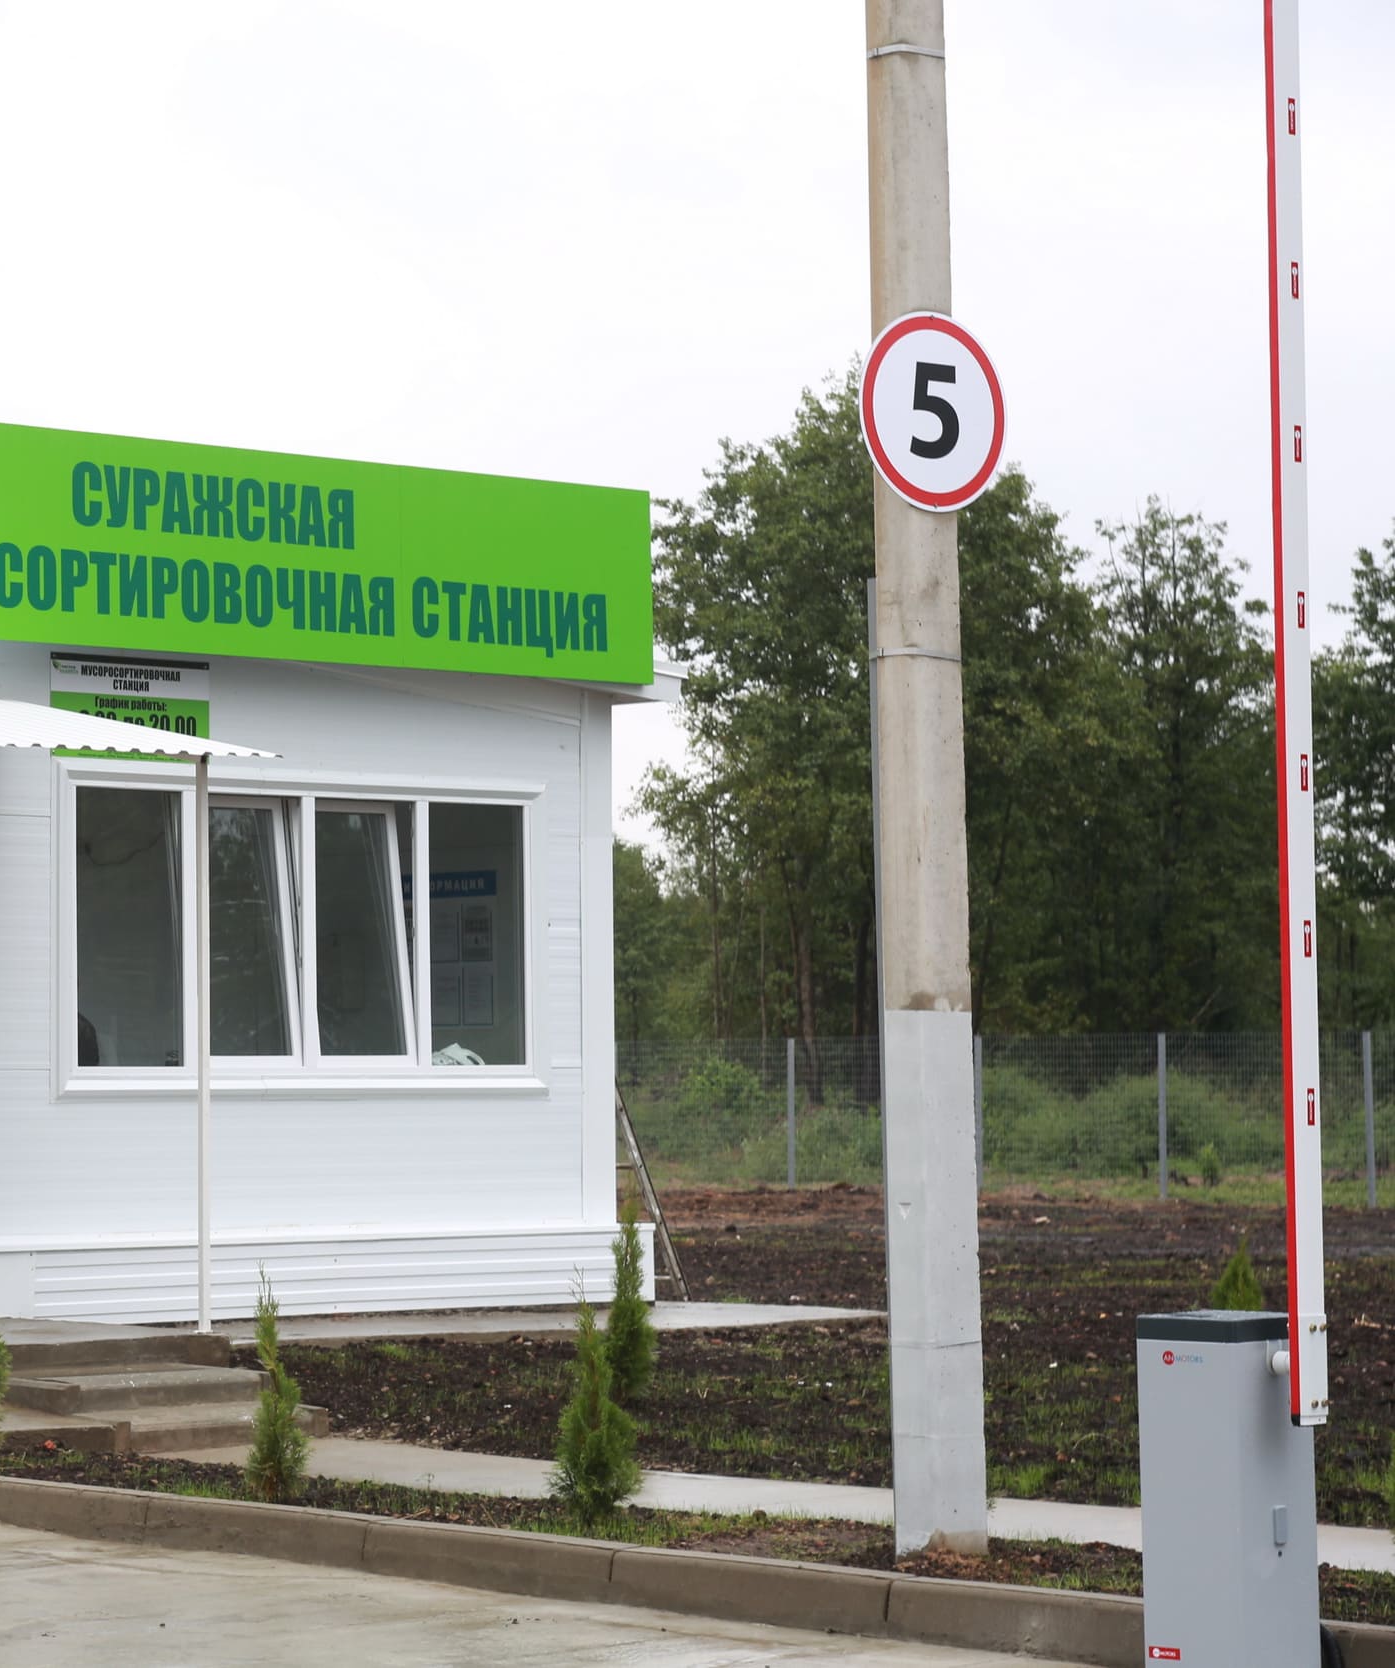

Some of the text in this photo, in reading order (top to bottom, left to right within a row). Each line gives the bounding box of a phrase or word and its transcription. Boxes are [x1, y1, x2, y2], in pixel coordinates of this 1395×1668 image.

[910, 361, 959, 459] 5
[72, 462, 354, 547] СУРАЖСКАЯ
[412, 577, 607, 658] СТАНЦИЯ
[81, 665, 181, 682] МУСОРОСОРТИРОВОЧНАЯ
[113, 679, 150, 693] СТАНЦИЯ
[95, 696, 167, 712] График работы:
